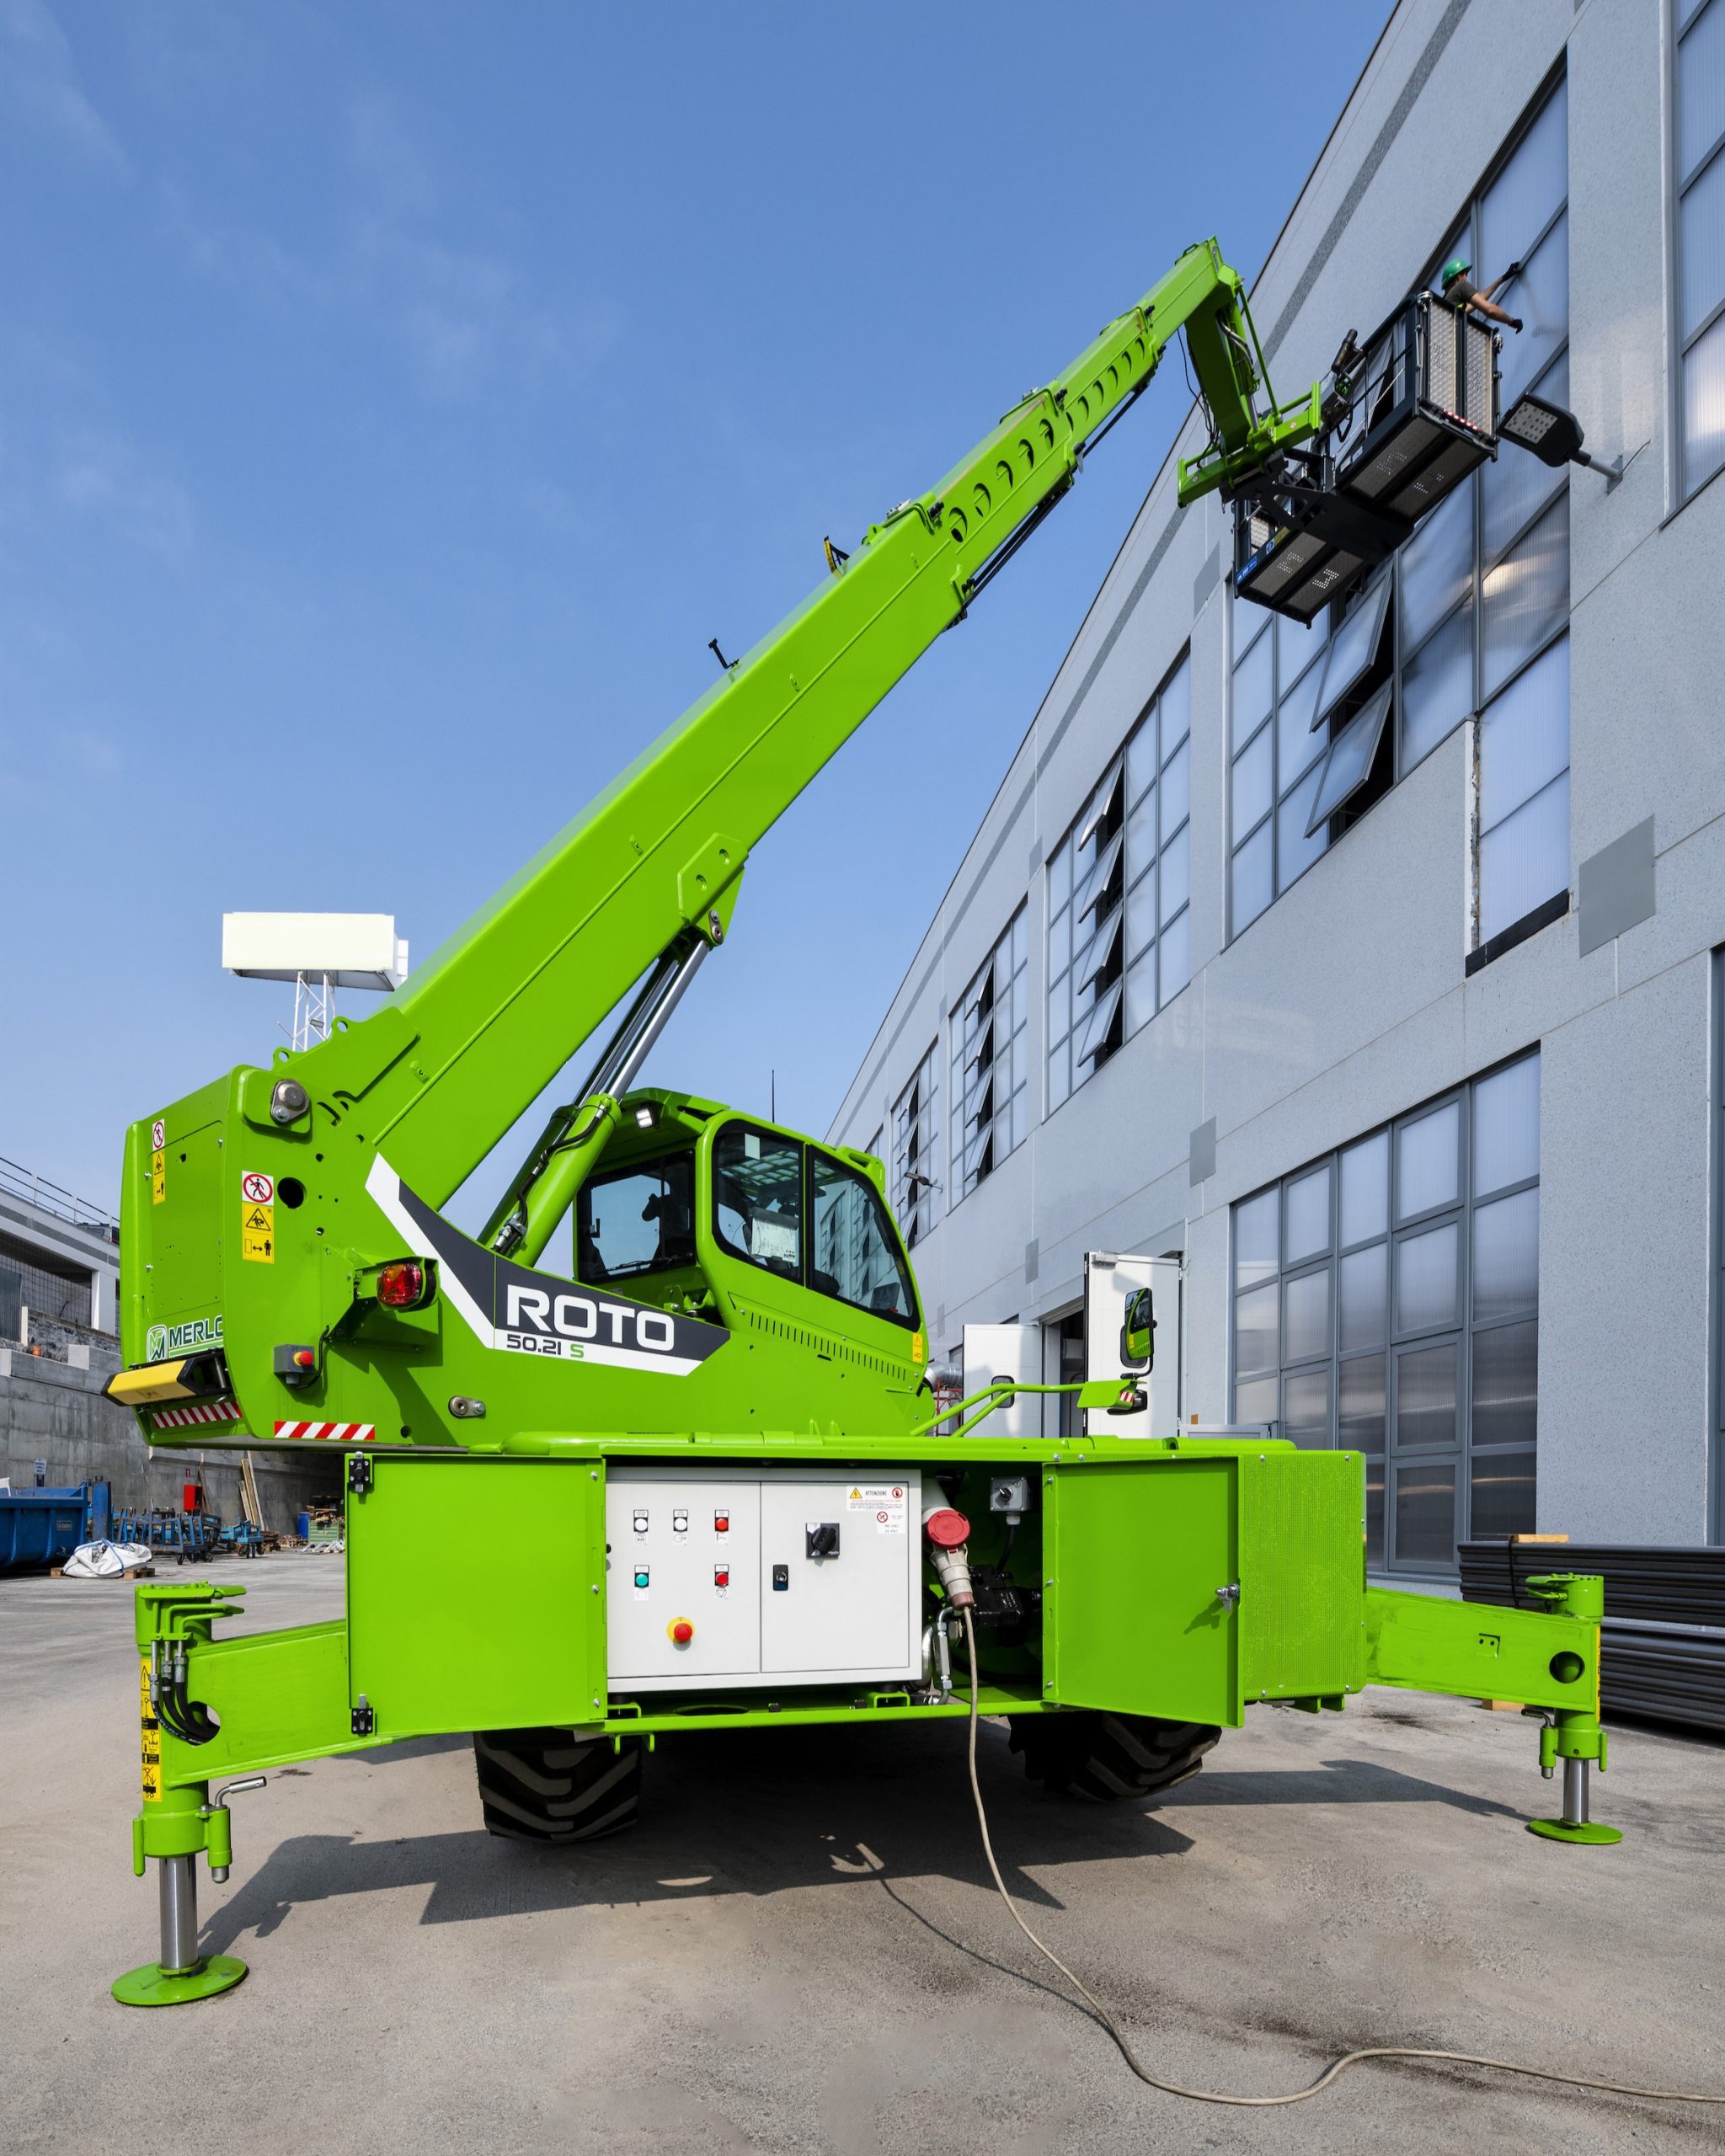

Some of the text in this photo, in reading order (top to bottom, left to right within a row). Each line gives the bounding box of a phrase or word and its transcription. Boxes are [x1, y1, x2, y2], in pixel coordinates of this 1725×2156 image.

[507, 1284, 675, 1352] ROTO
[507, 1334, 585, 1358] 50.21 S
